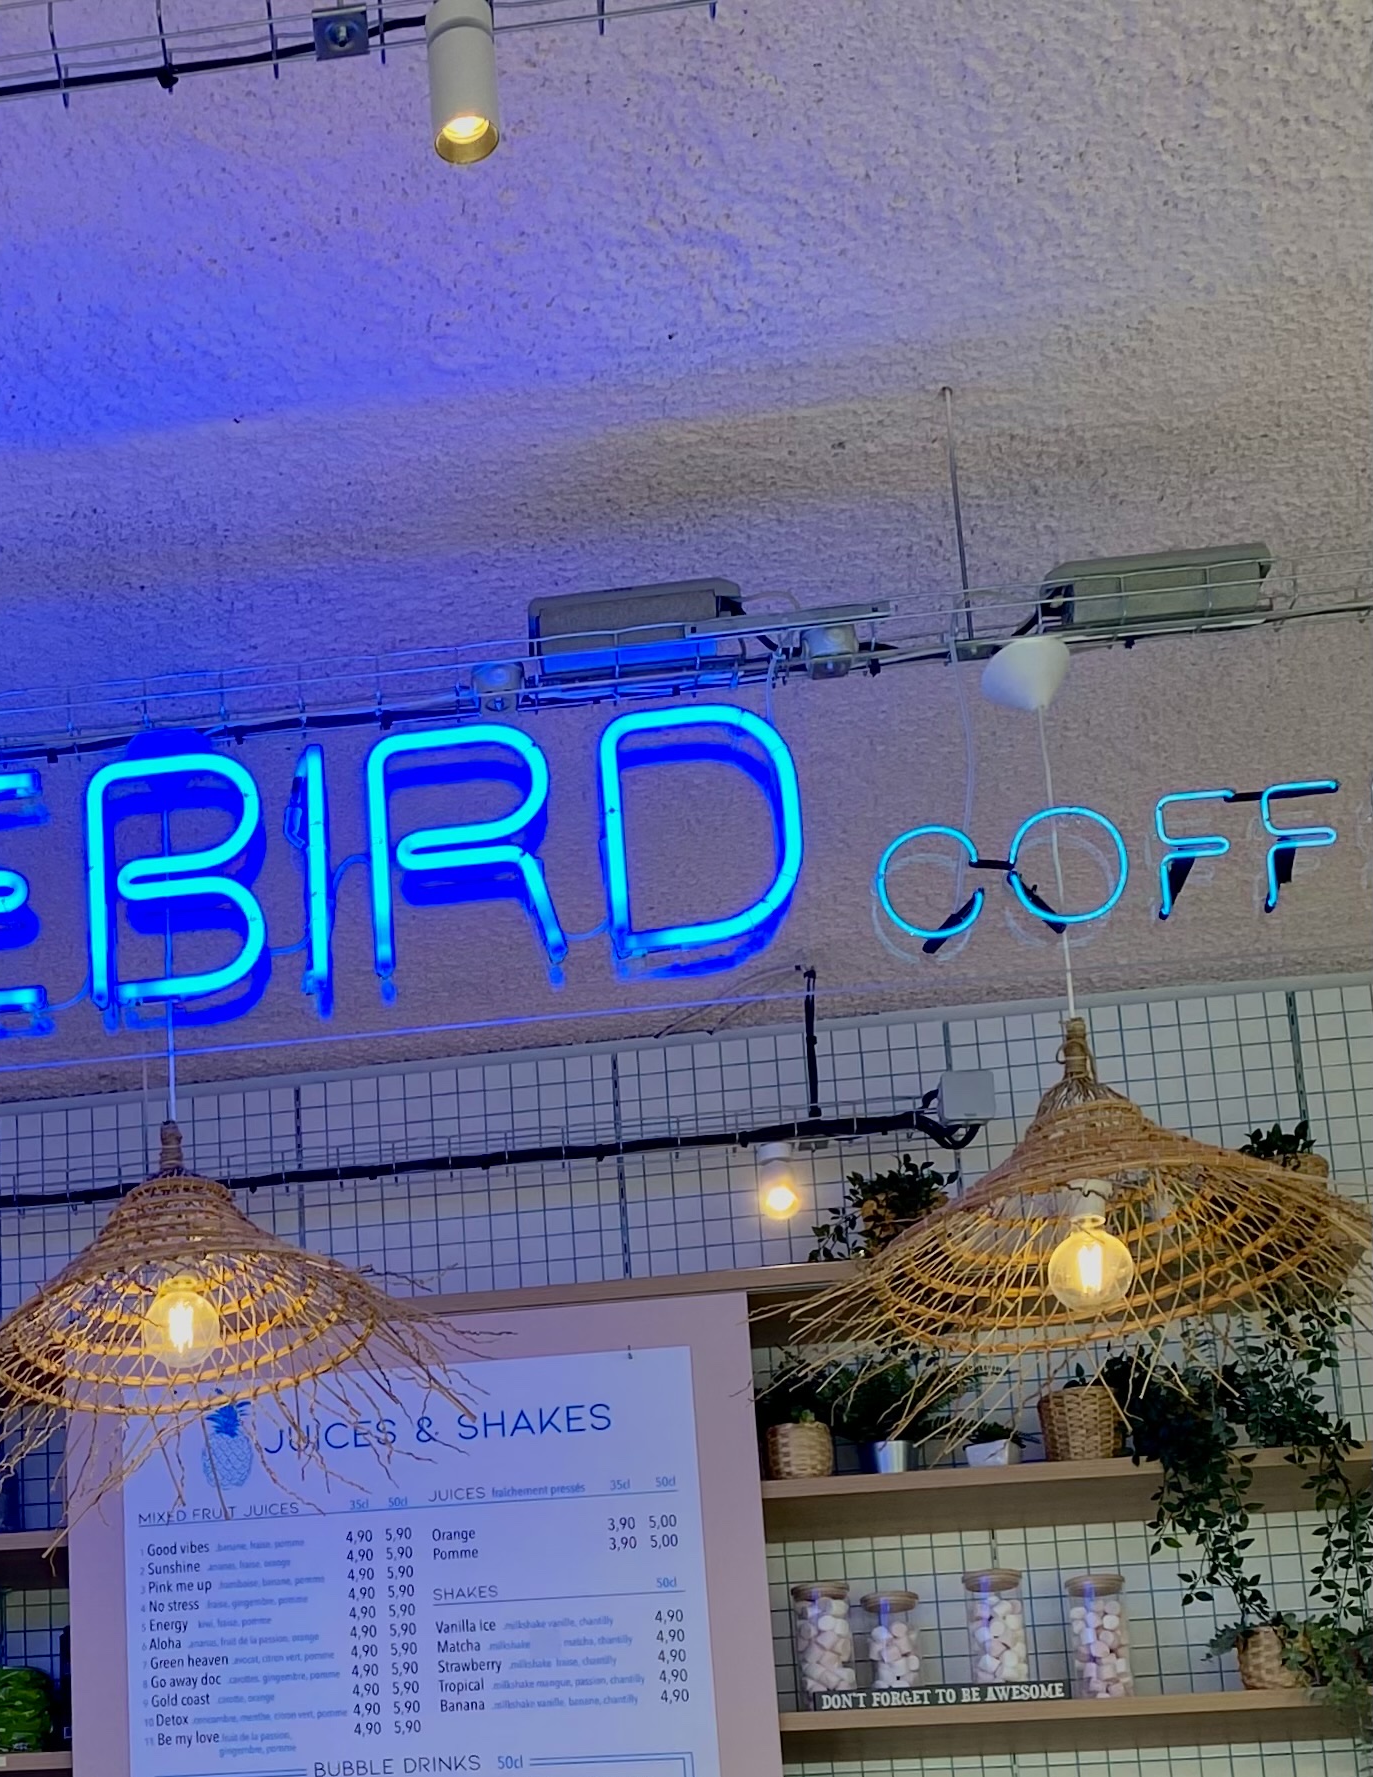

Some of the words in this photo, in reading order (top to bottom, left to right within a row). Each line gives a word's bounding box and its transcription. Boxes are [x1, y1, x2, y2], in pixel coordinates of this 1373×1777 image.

[876, 779, 1340, 940] COFF
[264, 1418, 396, 1454] JUICES
[416, 1416, 440, 1444] &
[457, 1403, 611, 1439] SHAKES
[429, 1487, 485, 1502] JUICES
[139, 1510, 186, 1524] MIXED
[193, 1506, 236, 1519] FRUIT
[244, 1502, 299, 1517] JUICES
[432, 1529, 475, 1543] Orange
[148, 1542, 177, 1556] Good
[180, 1541, 209, 1554] vibes
[434, 1548, 478, 1560] Pomme
[148, 1560, 200, 1575] Sunshine
[149, 1581, 172, 1593] Pink
[176, 1582, 194, 1592] me
[197, 1581, 211, 1593] up
[433, 1585, 498, 1600] SHAKES
[150, 1601, 164, 1612] No
[168, 1600, 199, 1612] stress
[150, 1619, 187, 1633] Energy
[436, 1619, 476, 1633] Vanilla
[150, 1637, 181, 1650] Aloha
[438, 1639, 480, 1653] Matcha
[151, 1657, 184, 1669] Green
[188, 1655, 228, 1667] heaven
[438, 1659, 501, 1673] Strawberry
[151, 1676, 166, 1688] Go
[170, 1677, 198, 1689] away
[201, 1673, 220, 1685] doc
[439, 1678, 484, 1695] Tropical
[152, 1693, 177, 1707] Gold
[181, 1693, 210, 1706] coast
[821, 1692, 867, 1710] DON'T
[872, 1689, 931, 1708] FORGET
[935, 1687, 957, 1705] TO
[961, 1686, 981, 1703] BE
[984, 1682, 1065, 1702] AWESOME
[441, 1700, 484, 1712] Banana
[156, 1714, 188, 1726] Detox
[158, 1733, 172, 1745] Be
[176, 1735, 192, 1748] my
[196, 1731, 219, 1743] love
[314, 1759, 394, 1777] BUBBLE
[404, 1755, 480, 1773] DRINKS
